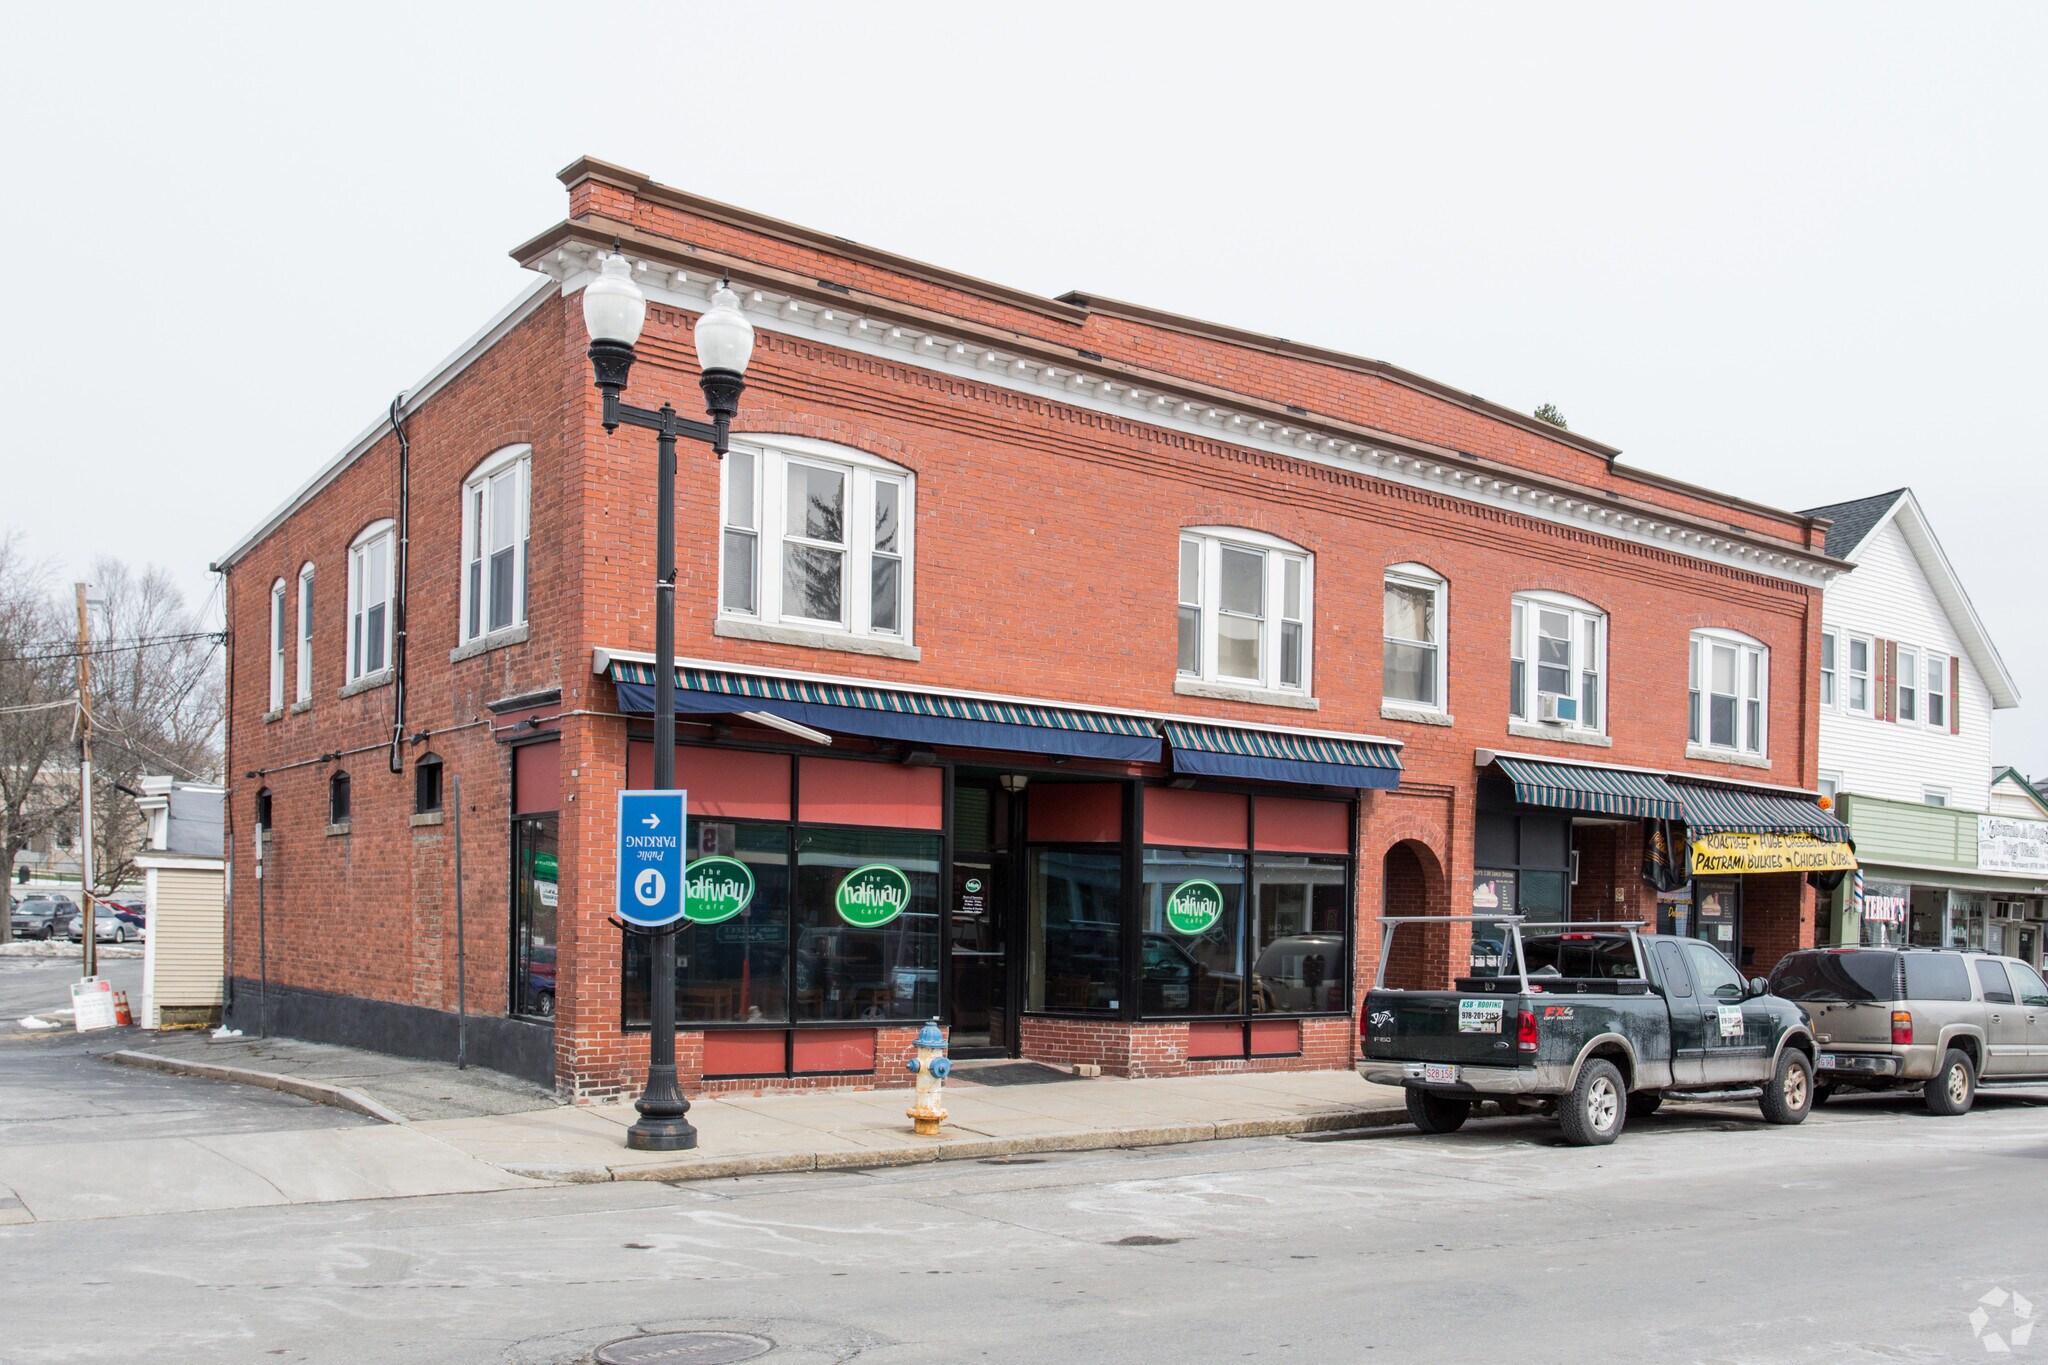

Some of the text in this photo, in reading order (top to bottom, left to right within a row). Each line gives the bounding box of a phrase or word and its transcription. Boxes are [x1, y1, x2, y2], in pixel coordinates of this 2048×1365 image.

[626, 836, 676, 848] PARKING
[1760, 834, 1783, 849] HUGE
[637, 851, 664, 861] Public
[1696, 853, 1744, 871] PASTRAMI
[1747, 854, 1783, 869] BULKIES
[1793, 851, 1828, 867] CHICKEN
[640, 874, 657, 899] P
[844, 882, 902, 911] halfway
[1173, 895, 1216, 919] halfway
[1864, 895, 1906, 922] TERRY'S
[1544, 1006, 1574, 1016] FX4
[1427, 1068, 1453, 1080] S28 158
